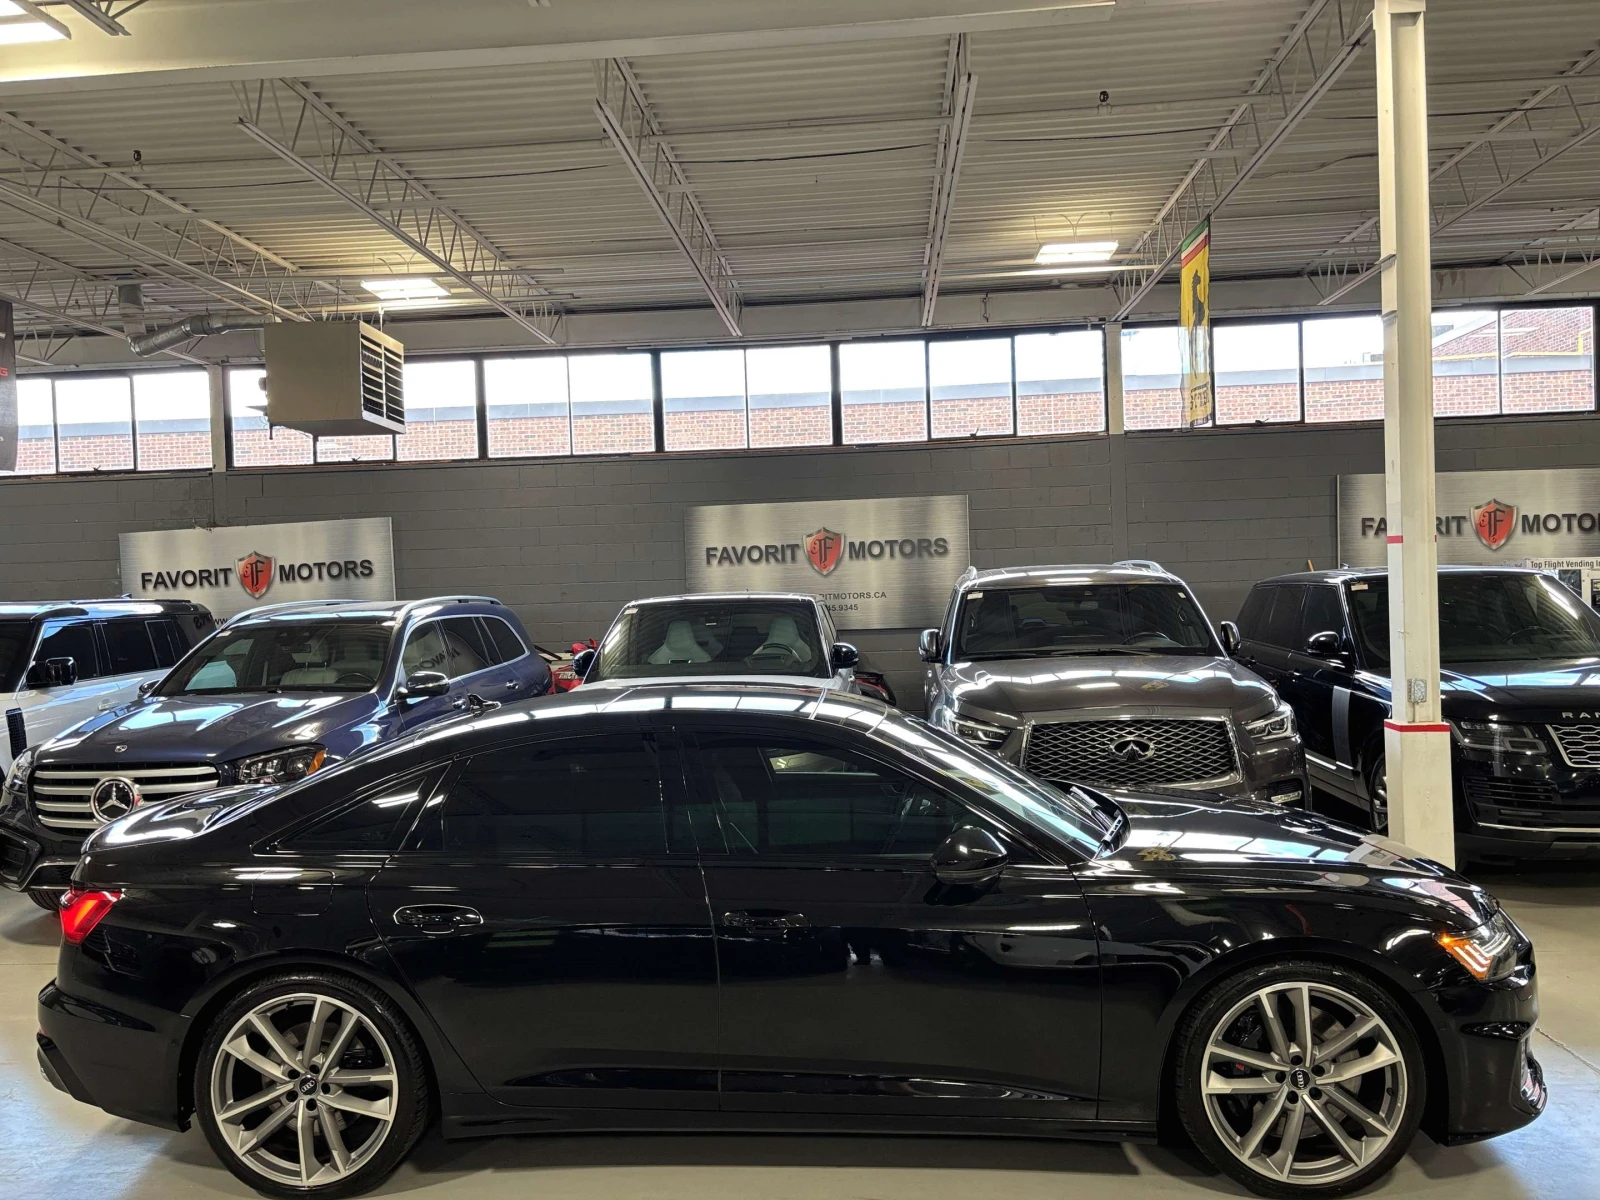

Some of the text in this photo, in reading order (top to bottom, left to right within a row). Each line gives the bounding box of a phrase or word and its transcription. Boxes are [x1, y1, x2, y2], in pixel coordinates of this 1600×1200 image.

[1361, 515, 1467, 536] FARIT
[1521, 512, 1600, 533] MOTO
[705, 543, 800, 565] FAVORIT
[848, 537, 949, 560] MOTORS
[141, 567, 233, 590] FAVORIT
[279, 559, 374, 582] MOTORS
[1530, 560, 1543, 569] Top
[1544, 560, 1565, 570] Flight
[1566, 559, 1595, 570] Vending
